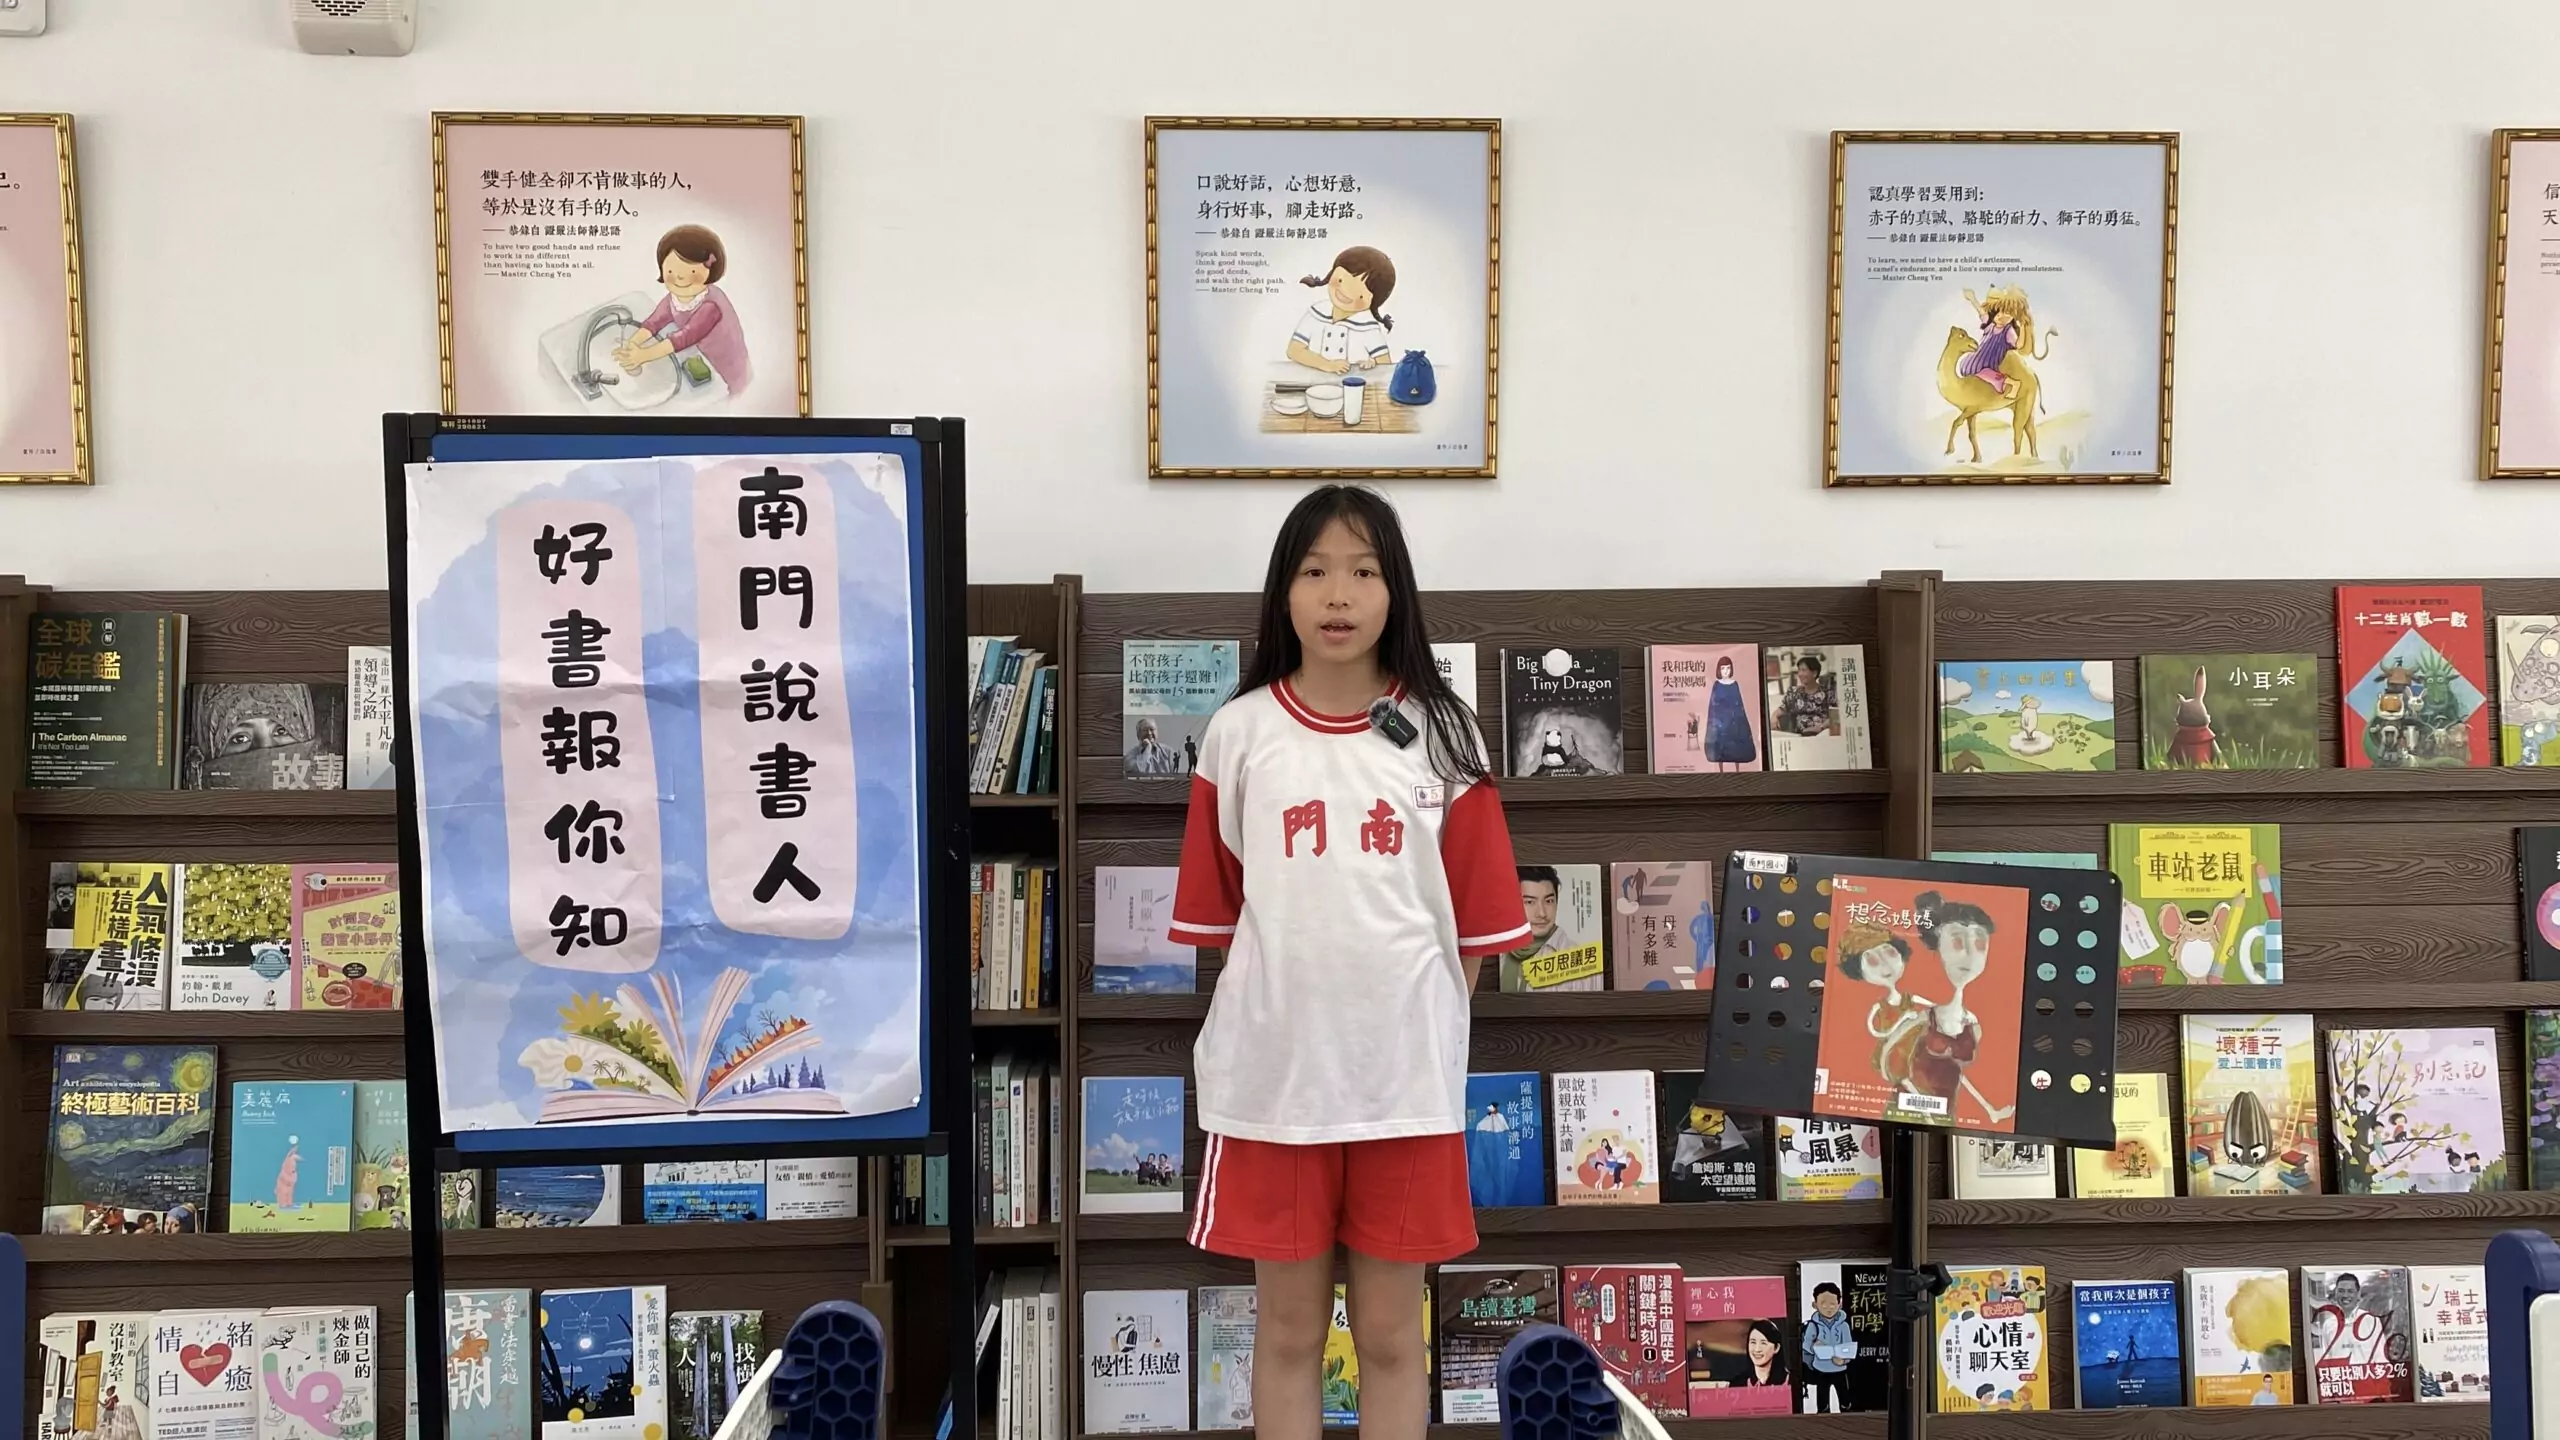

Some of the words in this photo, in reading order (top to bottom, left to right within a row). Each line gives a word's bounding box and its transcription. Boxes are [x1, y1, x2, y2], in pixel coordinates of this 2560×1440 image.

[482, 197, 640, 217] 等於是沒有手的人。
[484, 261, 501, 269] than
[504, 261, 531, 269] having
[533, 261, 543, 269] no
[546, 261, 569, 269] hands
[1195, 268, 1205, 276] do
[1207, 268, 1224, 276] good
[1873, 265, 1898, 273] camel's
[1939, 265, 1952, 273] and
[1959, 265, 1978, 273] lion's
[1978, 265, 2005, 273] courage
[2006, 265, 2019, 273] and
[1937, 257, 1953, 265] have
[1960, 257, 1982, 265] child's
[1196, 277, 1210, 285] and
[1212, 277, 1229, 285] walk
[1232, 277, 1244, 285] the
[1246, 277, 1264, 285] right
[1882, 274, 1906, 282] Master
[1907, 274, 1928, 282] Cheng
[1930, 274, 1943, 282] Yen
[2354, 610, 2468, 628] 十二生肖數一數
[36, 618, 93, 647] 全球
[35, 651, 121, 680] 碳年鑑
[1517, 656, 1539, 673] Big
[1662, 660, 1706, 673] 我和我的
[363, 658, 378, 720] 領導之路
[738, 466, 822, 904] 南門說書人
[1530, 676, 1559, 693] Tiny
[1563, 675, 1612, 692] Dragon
[1662, 675, 1706, 688] 失智媽媽
[1841, 657, 1860, 719] 講理就好
[2229, 667, 2296, 690] 小耳朵
[39, 732, 55, 742] The
[57, 732, 88, 742] Carbon
[90, 732, 127, 742] Almanac
[533, 522, 629, 956] 好書報你知
[272, 752, 344, 790] 故事
[2148, 851, 2245, 882] 車站老鼠
[1844, 900, 1935, 929] 想念媽媽
[124, 871, 168, 987] 人氣條漫
[1642, 914, 1660, 966] 有多難
[1662, 914, 1677, 949] 母愛
[1529, 946, 1597, 978] 不可思議男
[180, 993, 208, 1005] John
[212, 993, 249, 1006] Davey
[2216, 1035, 2282, 1056] 壞種子
[2217, 1057, 2282, 1070] 愛上圖書館
[2411, 1060, 2487, 1088] 別忘記
[62, 1078, 80, 1087] Art
[60, 1092, 200, 1116] 終極藝術百科
[1519, 1081, 1534, 1140] 薩提爾的
[1572, 1078, 1588, 1123] 說故事
[1557, 1078, 1574, 1153] 與親子共讀
[1506, 1100, 1521, 1160] 故事溝通
[1808, 1133, 1860, 1165] 風暴
[1700, 1174, 1756, 1186] 太空望遠鏡
[1855, 1273, 1878, 1284] NEW
[2080, 1287, 2170, 1302] 當我再次是個孩子
[2444, 1288, 2479, 1307] 瑞士
[1639, 1274, 1657, 1346] 關鍵時刻
[1658, 1274, 1675, 1364] 漫畫中國歷史
[1851, 1315, 1885, 1334] 同學
[1972, 1321, 2023, 1349] 心情
[109, 1322, 125, 1382] 沒事教室
[354, 1314, 371, 1378] 做自己的
[1858, 1347, 1877, 1357] JERRY
[676, 1347, 696, 1368] 人
[710, 1352, 722, 1363] 的
[1969, 1349, 2031, 1372] 聊天室
[2318, 1363, 2408, 1383] 只要比別人多2%
[2320, 1381, 2355, 1397] 就可以
